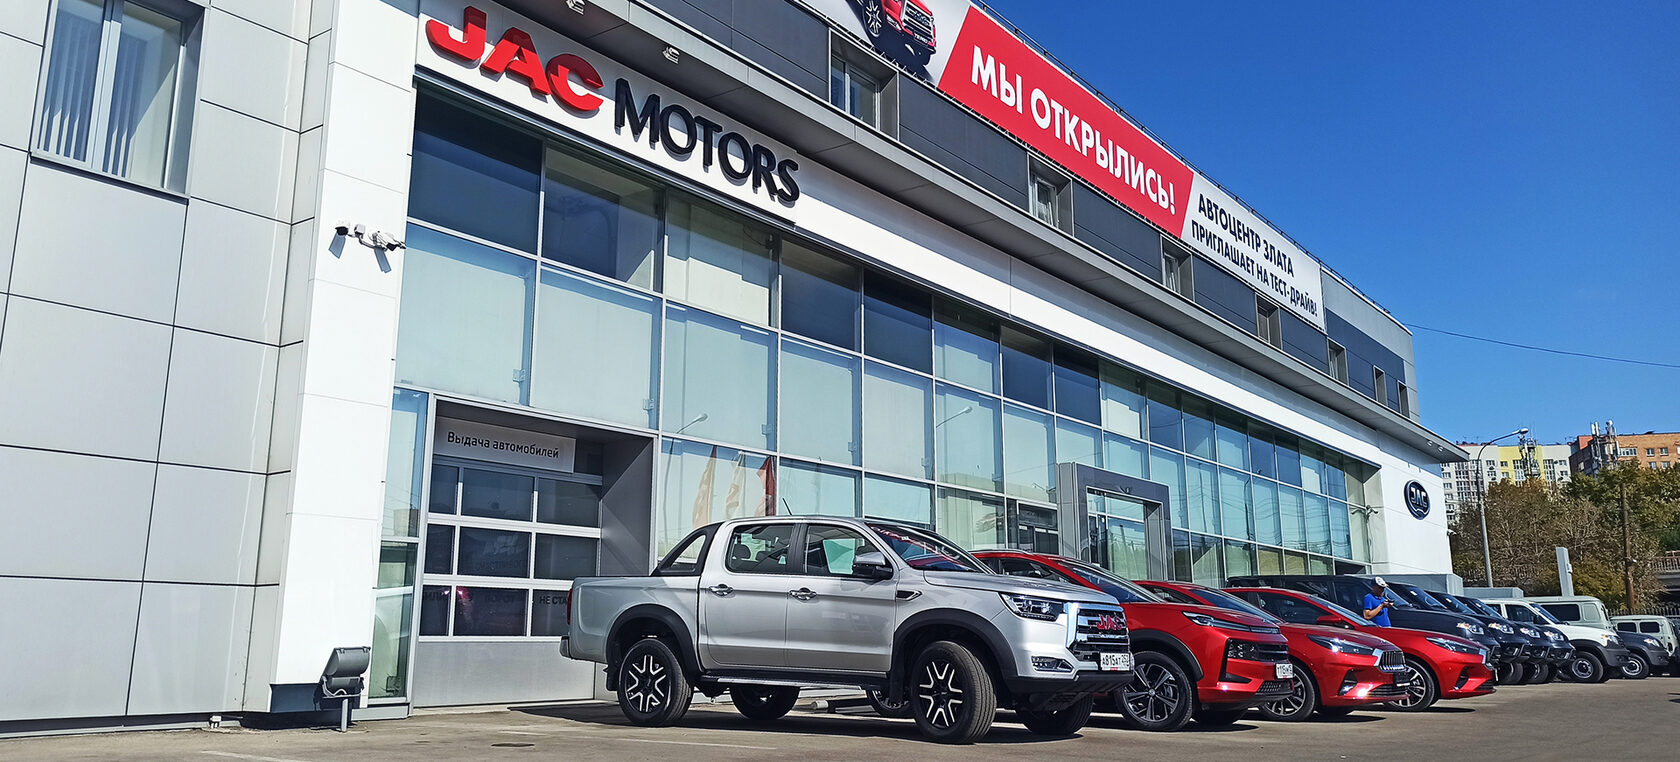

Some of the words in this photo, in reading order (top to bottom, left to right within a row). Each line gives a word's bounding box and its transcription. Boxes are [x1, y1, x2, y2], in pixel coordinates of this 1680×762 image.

[426, 6, 605, 112] JAC
[615, 78, 800, 204] MOTORS
[971, 45, 1023, 114] МЫ
[1031, 87, 1176, 215] ОТКРЫЛИСЬ!
[1198, 194, 1261, 252] АВТОЦЕНТР
[1262, 239, 1295, 278] ЗЛАТА
[1192, 219, 1254, 273] ПРИГЛАШАЕТ
[1256, 261, 1270, 287] НА
[1270, 269, 1318, 318] ТЕСТ-ДРАЙВ!
[447, 431, 490, 449] Выдача
[492, 440, 559, 458] автомобилей
[1410, 487, 1427, 507] JAC
[539, 595, 551, 604] НЕ
[552, 595, 568, 606] СТА
[1097, 615, 1121, 630] JAC
